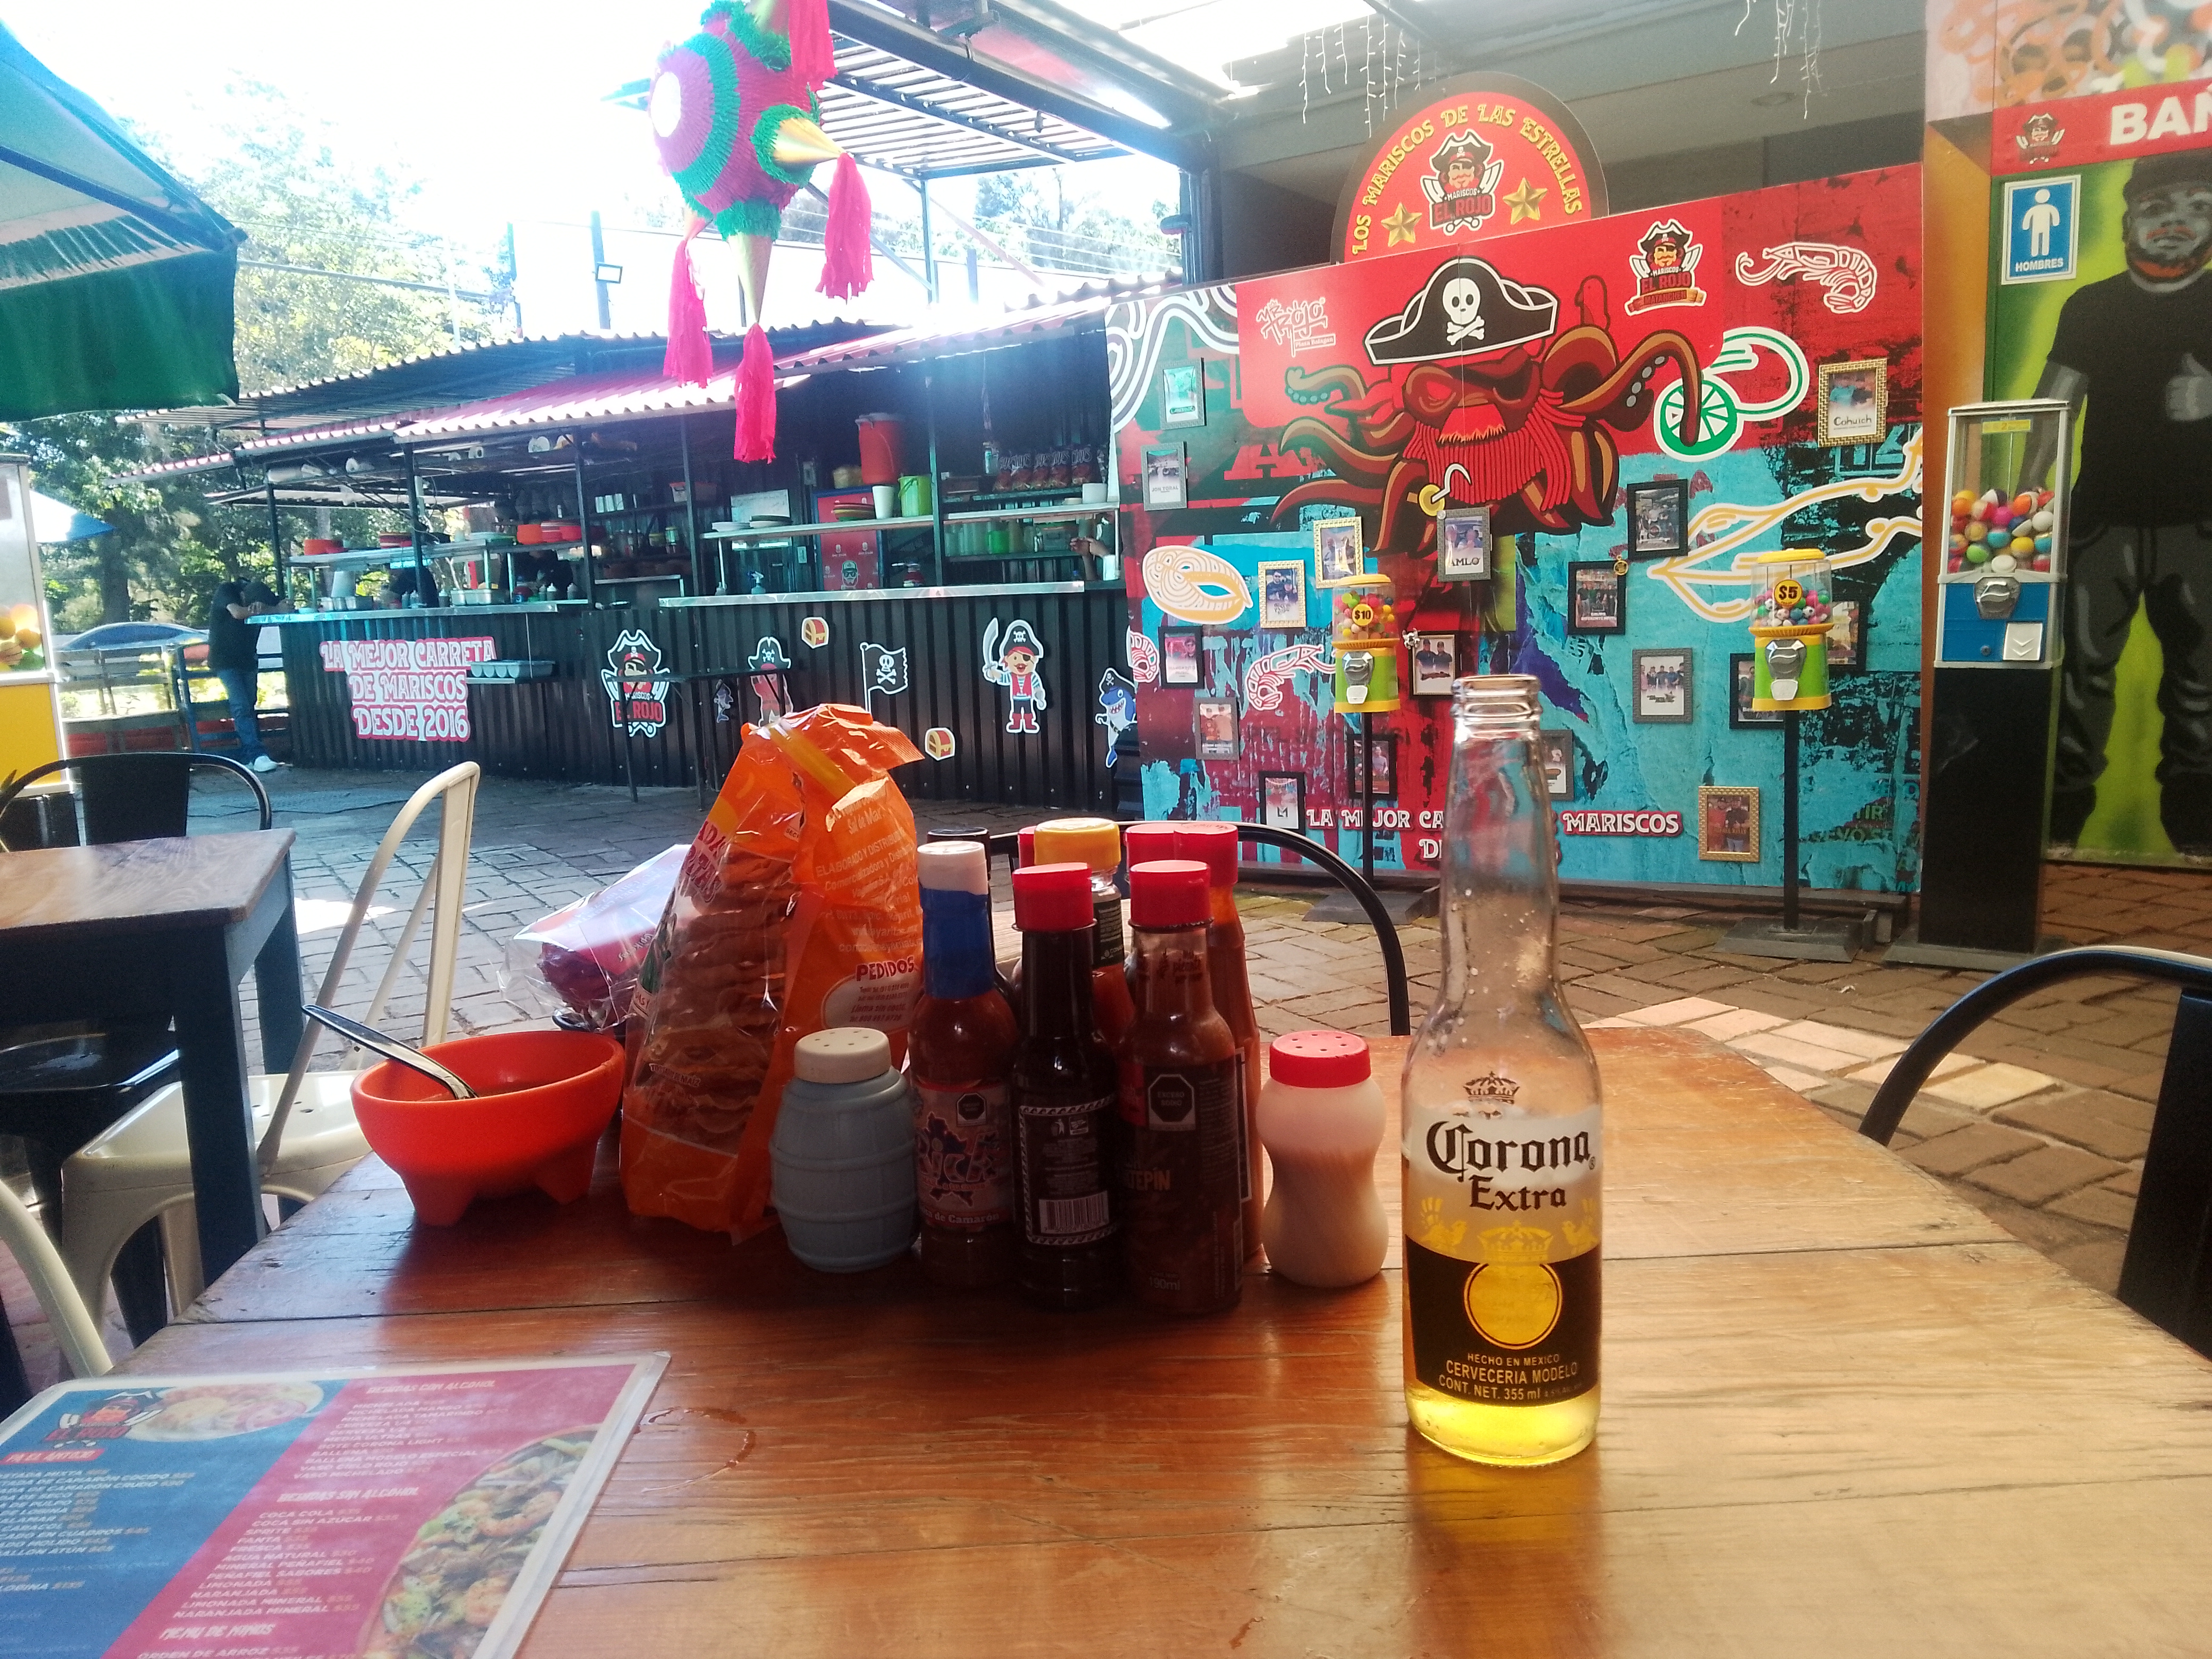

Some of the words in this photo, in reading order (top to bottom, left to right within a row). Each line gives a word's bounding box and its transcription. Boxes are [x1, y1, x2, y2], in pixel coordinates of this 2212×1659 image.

[1352, 214, 1372, 255] LOS
[1362, 119, 1435, 206] MARISCOS
[1440, 105, 1469, 128] DE
[1478, 104, 1516, 128] LAS
[1520, 116, 1582, 215] ESTRELLAS
[1447, 188, 1477, 202] MARISCOS
[1434, 204, 1452, 224] EL
[1455, 197, 1492, 217] ROJO
[1653, 266, 1679, 277] MARISCOS
[2015, 258, 2064, 273] HOMBRES
[1641, 278, 1656, 294] EL
[1659, 272, 1691, 289] ROJO
[1778, 585, 1798, 600] $5
[1354, 609, 1371, 621] $10
[320, 641, 344, 668] LA
[348, 640, 410, 668] MEJOR
[415, 640, 495, 668] CARRETA
[349, 674, 375, 701] DE
[379, 673, 466, 700] MARISCOS
[632, 700, 663, 722] ROJO
[354, 708, 418, 738] DESDE
[424, 708, 467, 739] 2016
[1306, 809, 1333, 827] LA
[1561, 812, 1680, 834] MARISCOS
[856, 955, 915, 982] PEDIDOS
[1426, 1120, 1591, 1183] Corona
[1468, 1174, 1567, 1212] Extra
[934, 1210, 945, 1221] de
[948, 1212, 1000, 1224] Camarón
[1148, 1276, 1180, 1291] 190ml
[1467, 1353, 1503, 1367] HECHO
[1506, 1356, 1520, 1367] EN
[1523, 1353, 1560, 1367] MEXICO
[1446, 1360, 1527, 1385] CERVECERIA
[1532, 1361, 1579, 1384] MODELO
[447, 1380, 496, 1389] ALCOHOL
[1438, 1374, 1471, 1395] CONT.
[1473, 1385, 1501, 1400] NET.
[1504, 1387, 1524, 1401] 355
[1527, 1387, 1541, 1400] ml
[277, 1568, 341, 1577] SABORES
[199, 1579, 273, 1588] LIMONADA
[191, 1588, 279, 1598] NARANJADA
[182, 1599, 258, 1608] LIMONADA
[261, 1596, 324, 1605] MINERAL
[174, 1608, 263, 1618] NARANJADA
[266, 1605, 330, 1614] MINERAL
